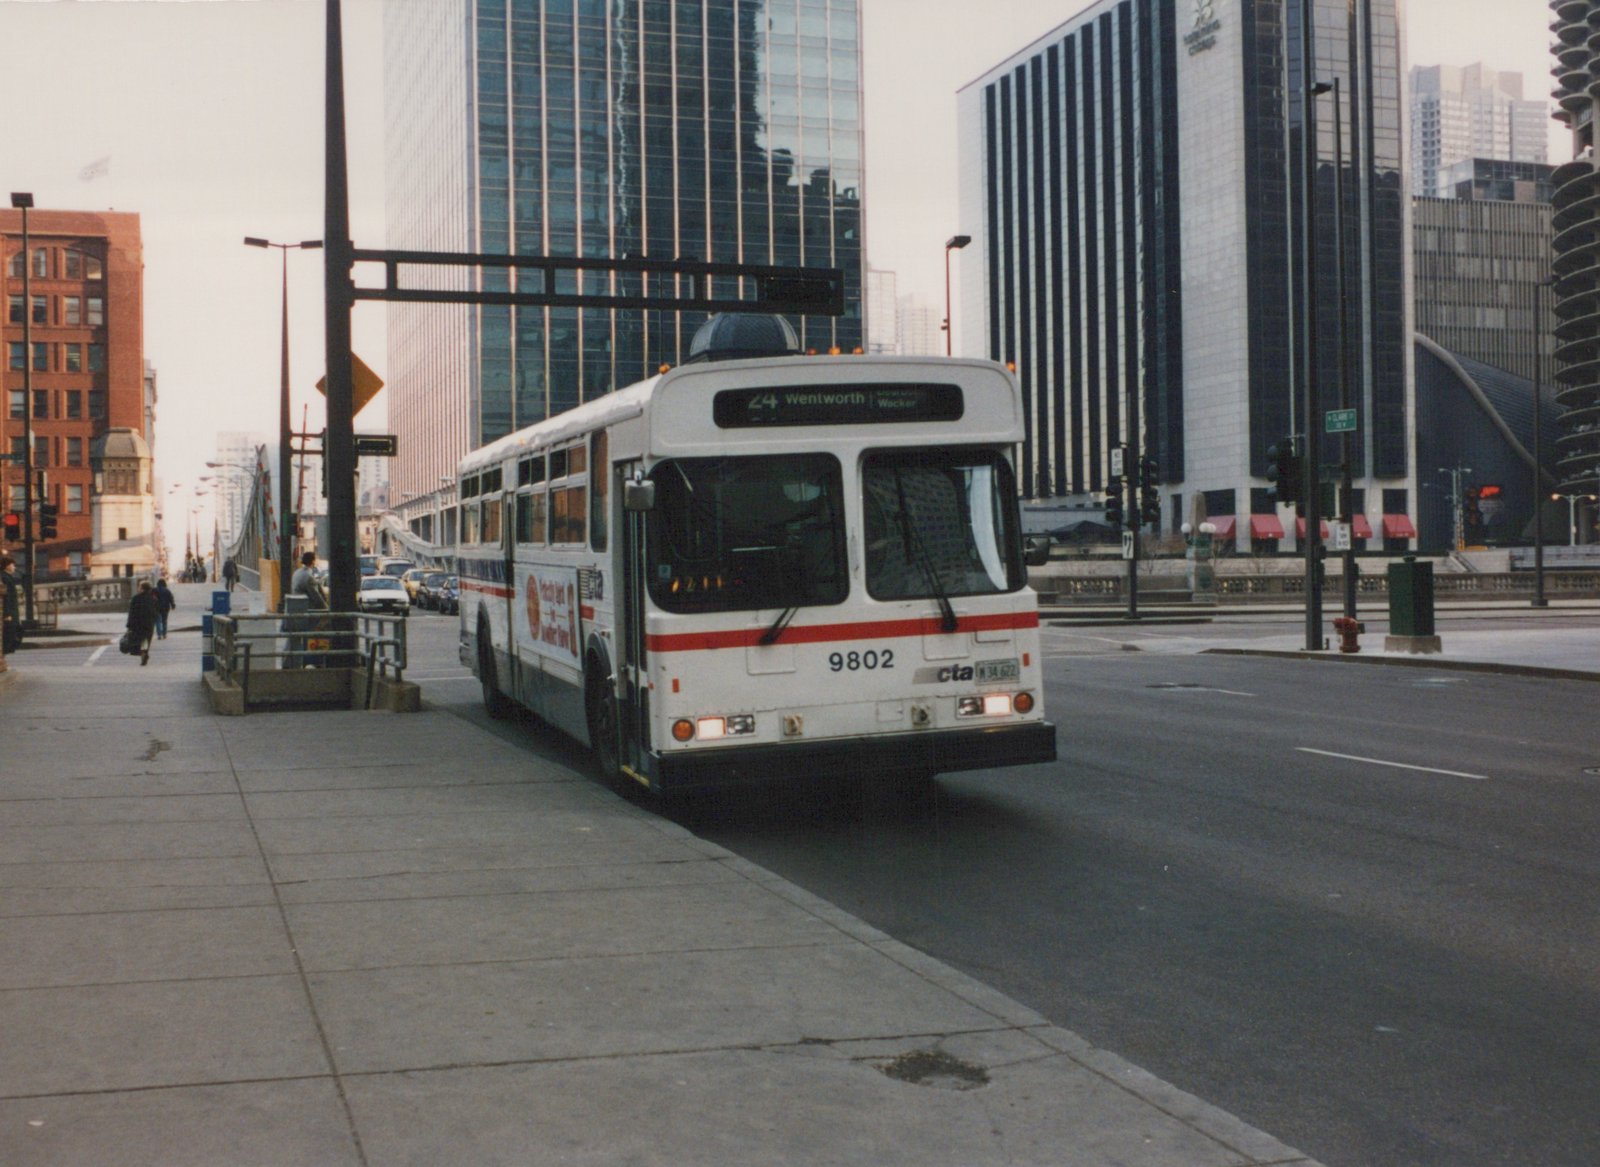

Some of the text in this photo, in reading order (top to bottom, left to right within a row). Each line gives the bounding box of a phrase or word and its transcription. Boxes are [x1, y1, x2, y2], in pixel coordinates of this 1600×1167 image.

[748, 391, 865, 409] 24 Wentworth
[878, 398, 916, 409] Wacker
[829, 650, 894, 672] 9802
[937, 663, 974, 682] cta
